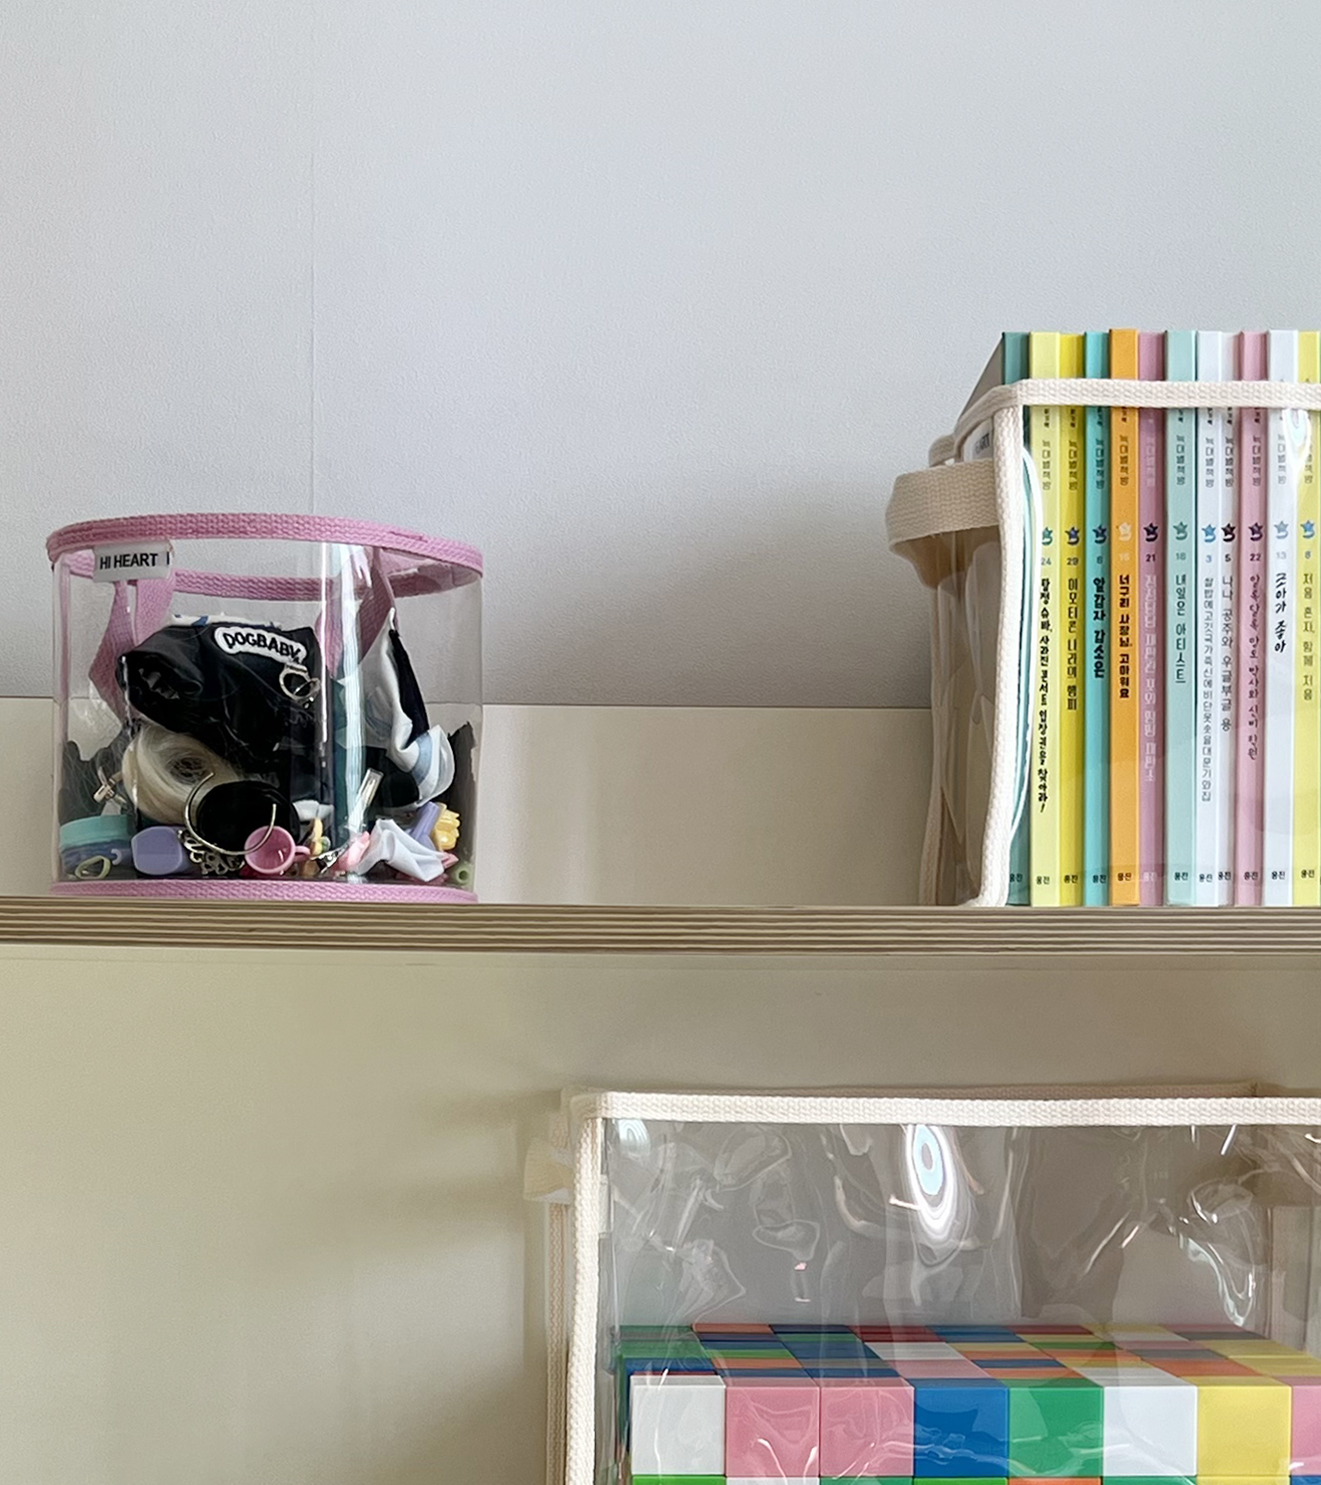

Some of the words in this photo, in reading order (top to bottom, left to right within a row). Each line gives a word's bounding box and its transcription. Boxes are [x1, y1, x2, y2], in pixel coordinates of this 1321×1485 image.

[99, 556, 111, 569] HI
[113, 553, 158, 568] HEART
[1041, 557, 1051, 565] 24
[1146, 554, 1156, 562] 21
[1224, 553, 1232, 562] 5
[1249, 553, 1261, 562] 22
[1119, 574, 1131, 608] 너구리
[1175, 573, 1187, 617] 내일은
[1174, 622, 1187, 684] 아티스트
[1119, 653, 1131, 699] 고마워요
[1117, 871, 1132, 882] 웅진
[1174, 871, 1189, 881] 웅진
[1198, 873, 1213, 883] 웅진
[1218, 870, 1232, 881] 웅진
[1244, 871, 1258, 881] 웅진
[1271, 871, 1286, 881] 웅진
[1301, 868, 1315, 879] 웅진
[1036, 875, 1050, 885] 웅진
[1063, 874, 1079, 885] 웅진
[1092, 874, 1107, 885] 웅진
